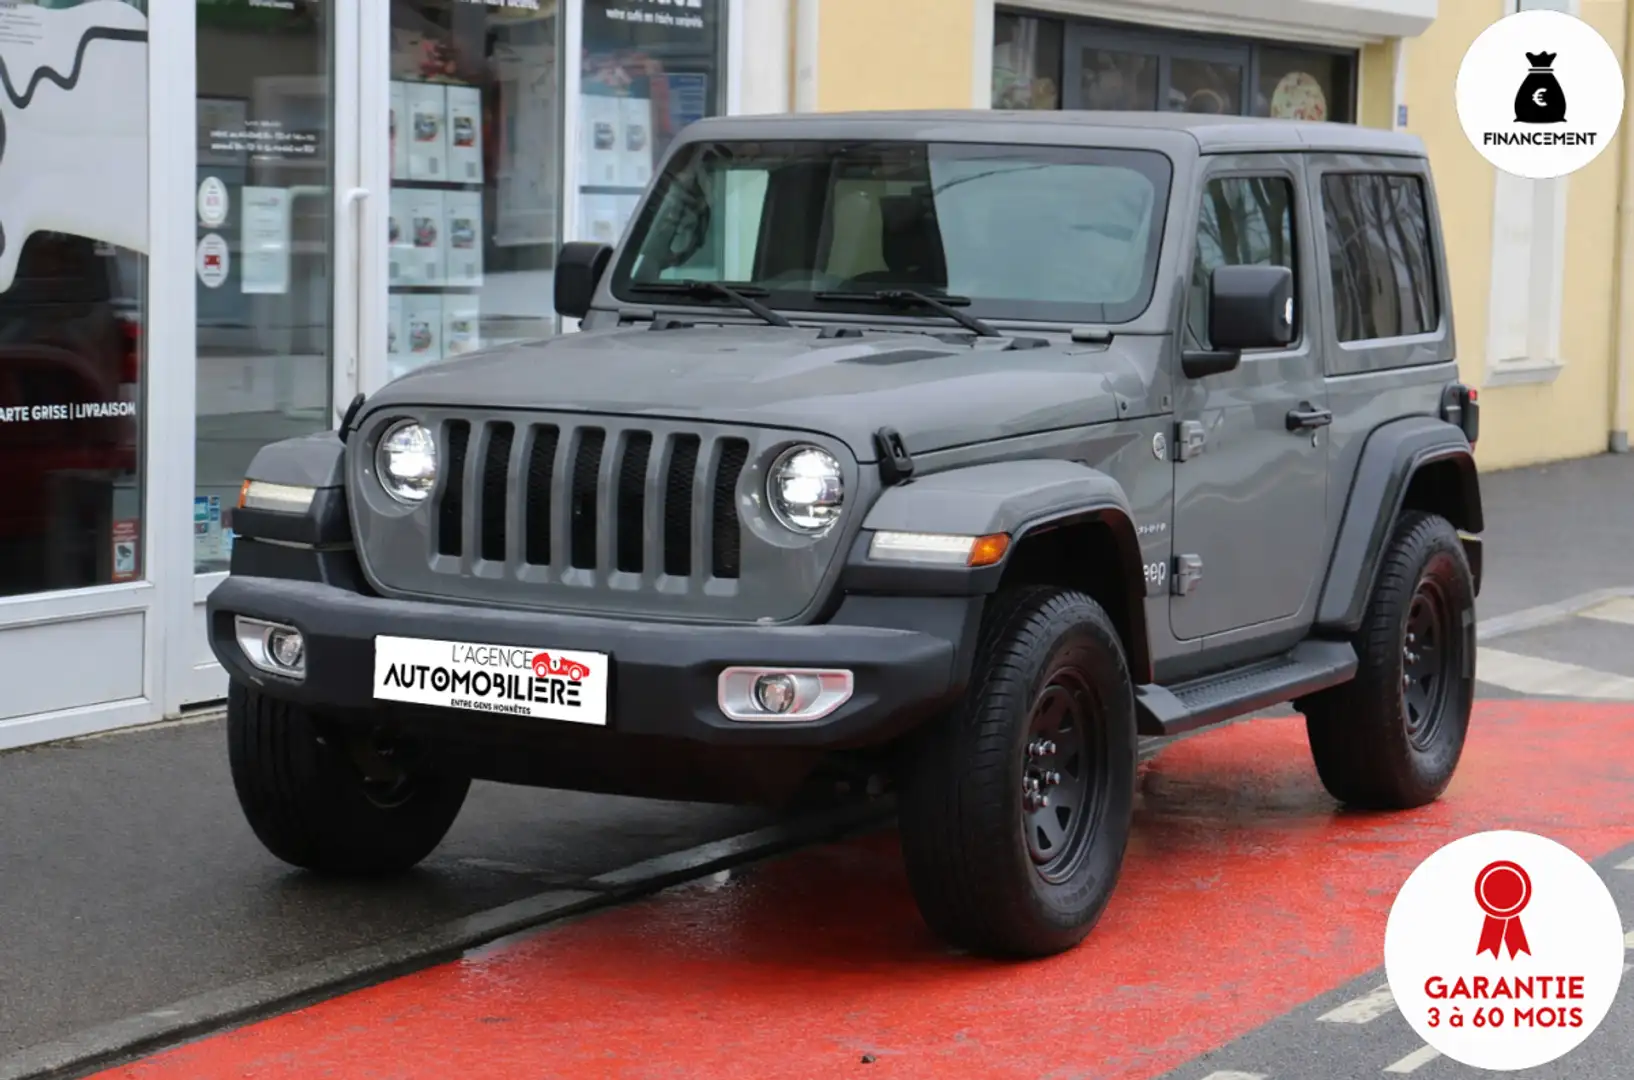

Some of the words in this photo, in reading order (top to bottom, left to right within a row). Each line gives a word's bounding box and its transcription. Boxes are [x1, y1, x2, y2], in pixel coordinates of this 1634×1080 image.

[0, 406, 29, 422] ARTE
[31, 404, 68, 420] GRISE
[75, 402, 136, 418] LIVRAISON
[1143, 561, 1167, 585] eep
[451, 644, 533, 670] L'AGENCE
[450, 698, 473, 709] ENTRE
[473, 701, 492, 711] GENS
[493, 702, 531, 715] HONNÊTES
